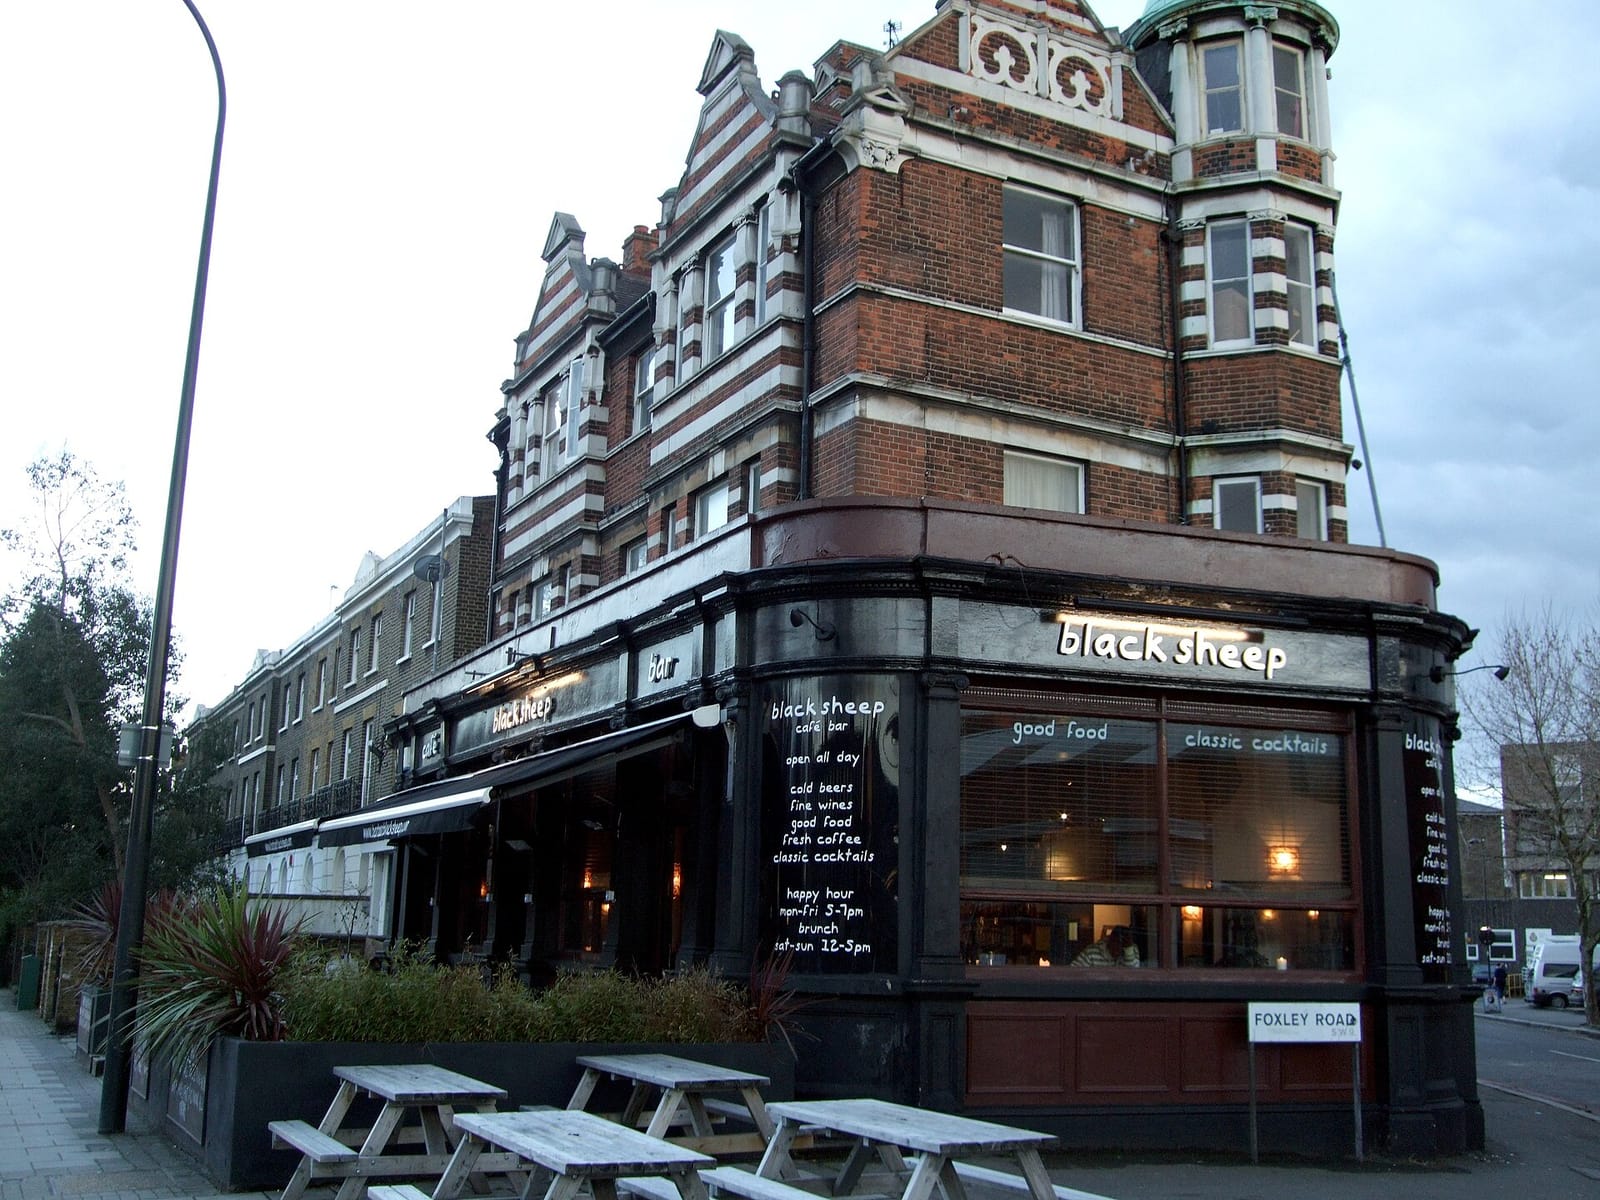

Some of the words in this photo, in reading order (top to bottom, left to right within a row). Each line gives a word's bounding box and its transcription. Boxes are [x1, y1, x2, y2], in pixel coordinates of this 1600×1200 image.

[1057, 620, 1168, 662] black
[1173, 632, 1287, 680] sheep
[648, 653, 679, 682] bar
[492, 700, 520, 734] black
[520, 695, 551, 724] sheep
[772, 697, 817, 721] black
[821, 696, 885, 718] sheep
[796, 719, 821, 734] café
[828, 719, 848, 732] bar
[1013, 720, 1055, 745] good
[1067, 721, 1108, 740] food
[1185, 731, 1243, 750] classic
[1252, 735, 1328, 754] cocktails
[1405, 733, 1436, 753] black
[786, 755, 811, 769] open
[816, 751, 830, 763] all
[837, 751, 860, 768] day
[790, 782, 813, 794] cold
[819, 782, 853, 794] beers
[790, 800, 812, 812] fine
[818, 799, 853, 811] wines
[791, 815, 816, 835] good
[824, 815, 852, 828] food
[783, 833, 812, 846] fresh
[817, 832, 862, 845] coffee
[773, 851, 809, 863] classic
[814, 849, 875, 862] cocktails
[787, 887, 820, 904] happy
[826, 887, 854, 900] hour
[780, 905, 819, 918] mon-fri
[825, 904, 864, 921] 5-7pm
[799, 922, 839, 935] brunch
[774, 938, 813, 952] sat-sun
[821, 938, 871, 956] 12-5pm
[1255, 1013, 1309, 1026] FOXLEY
[1316, 1013, 1356, 1026] ROAD
